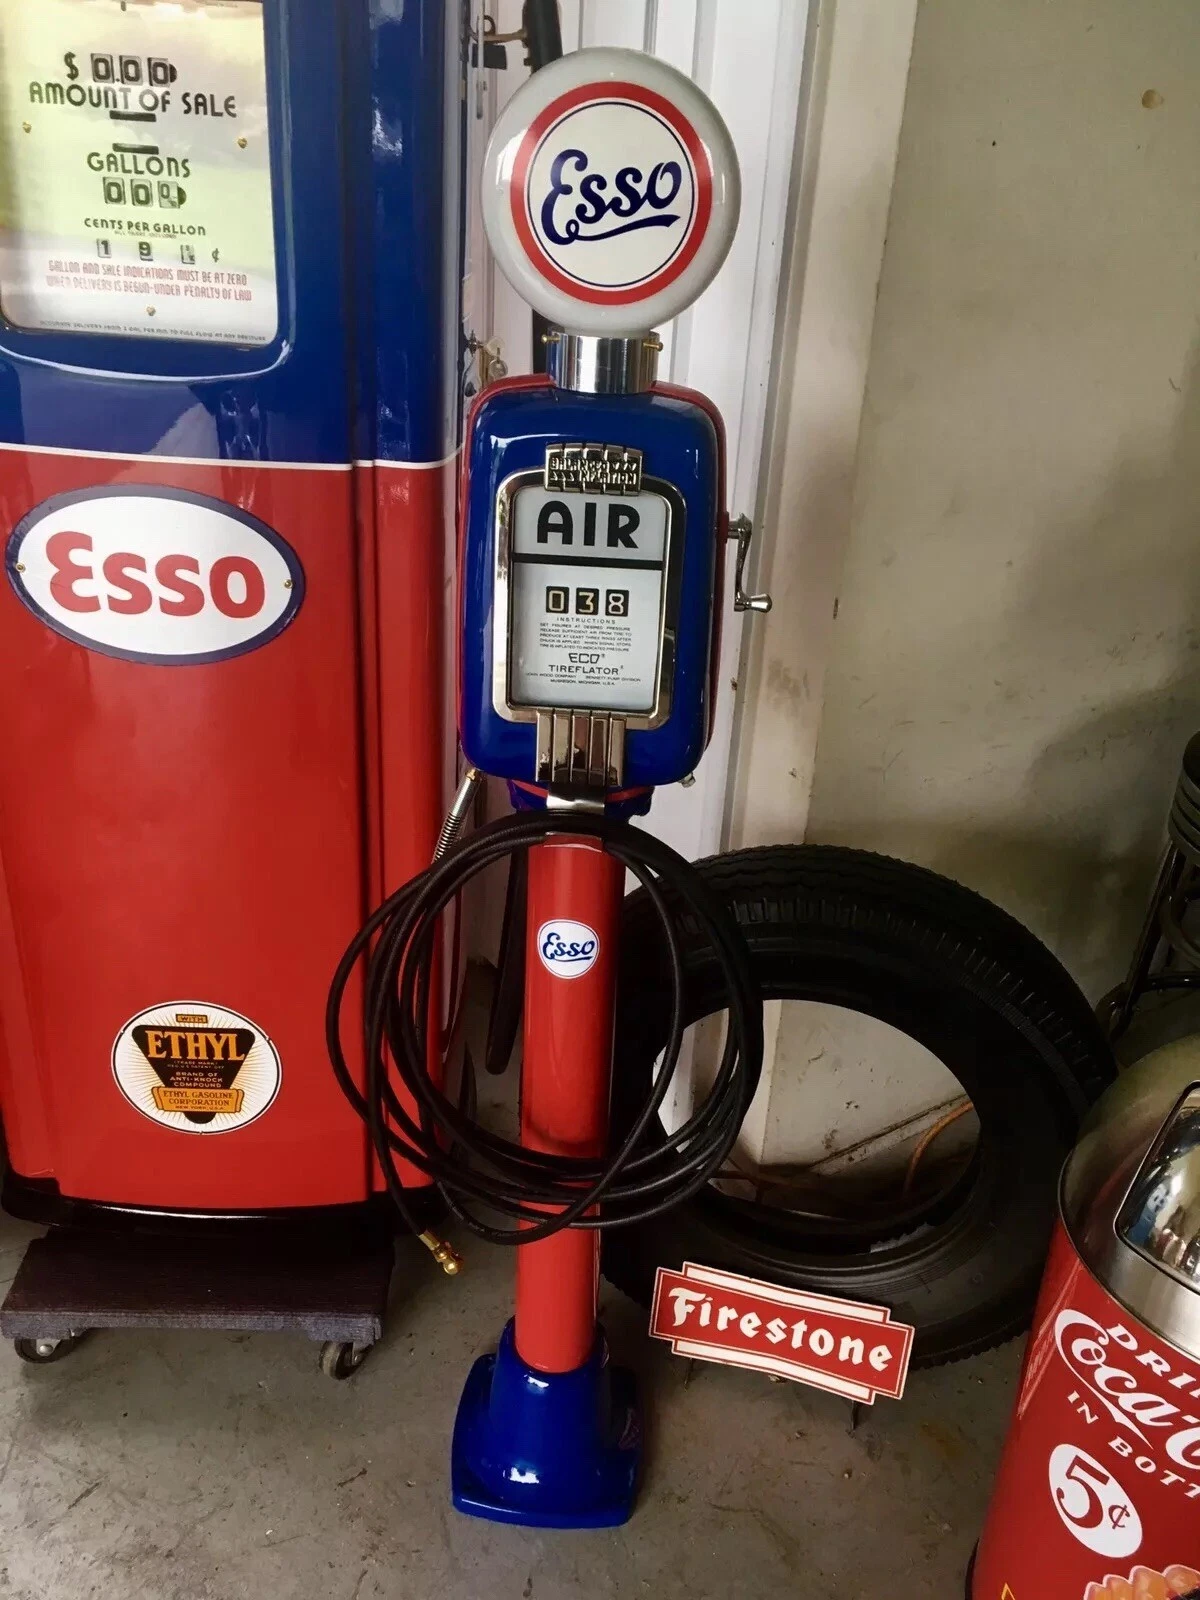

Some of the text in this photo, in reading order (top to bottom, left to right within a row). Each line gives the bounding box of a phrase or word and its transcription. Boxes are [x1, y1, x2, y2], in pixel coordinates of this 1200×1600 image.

[29, 81, 237, 119] AMOUNT OF SALE
[87, 151, 191, 178] GALLONS
[540, 148, 682, 246] Esso
[84, 217, 206, 236] CENTS PER GALLON
[177, 269, 199, 282] MUST
[201, 271, 212, 283] BE
[214, 272, 225, 285] AT
[227, 273, 247, 286] ZERO
[184, 284, 220, 300] PENALTY
[222, 288, 232, 300] OF
[234, 290, 252, 301] LAW
[536, 500, 641, 549] AIR
[548, 589, 625, 615] 038
[556, 617, 616, 625] INSTRUCTIONS
[542, 931, 595, 963] Esso
[144, 1029, 246, 1061] ETHYL
[163, 1090, 234, 1099] ETHYL GASOLINE
[168, 1098, 230, 1106] CORPORATION
[668, 1286, 893, 1372] Firestone
[1066, 1390, 1099, 1424] IN
